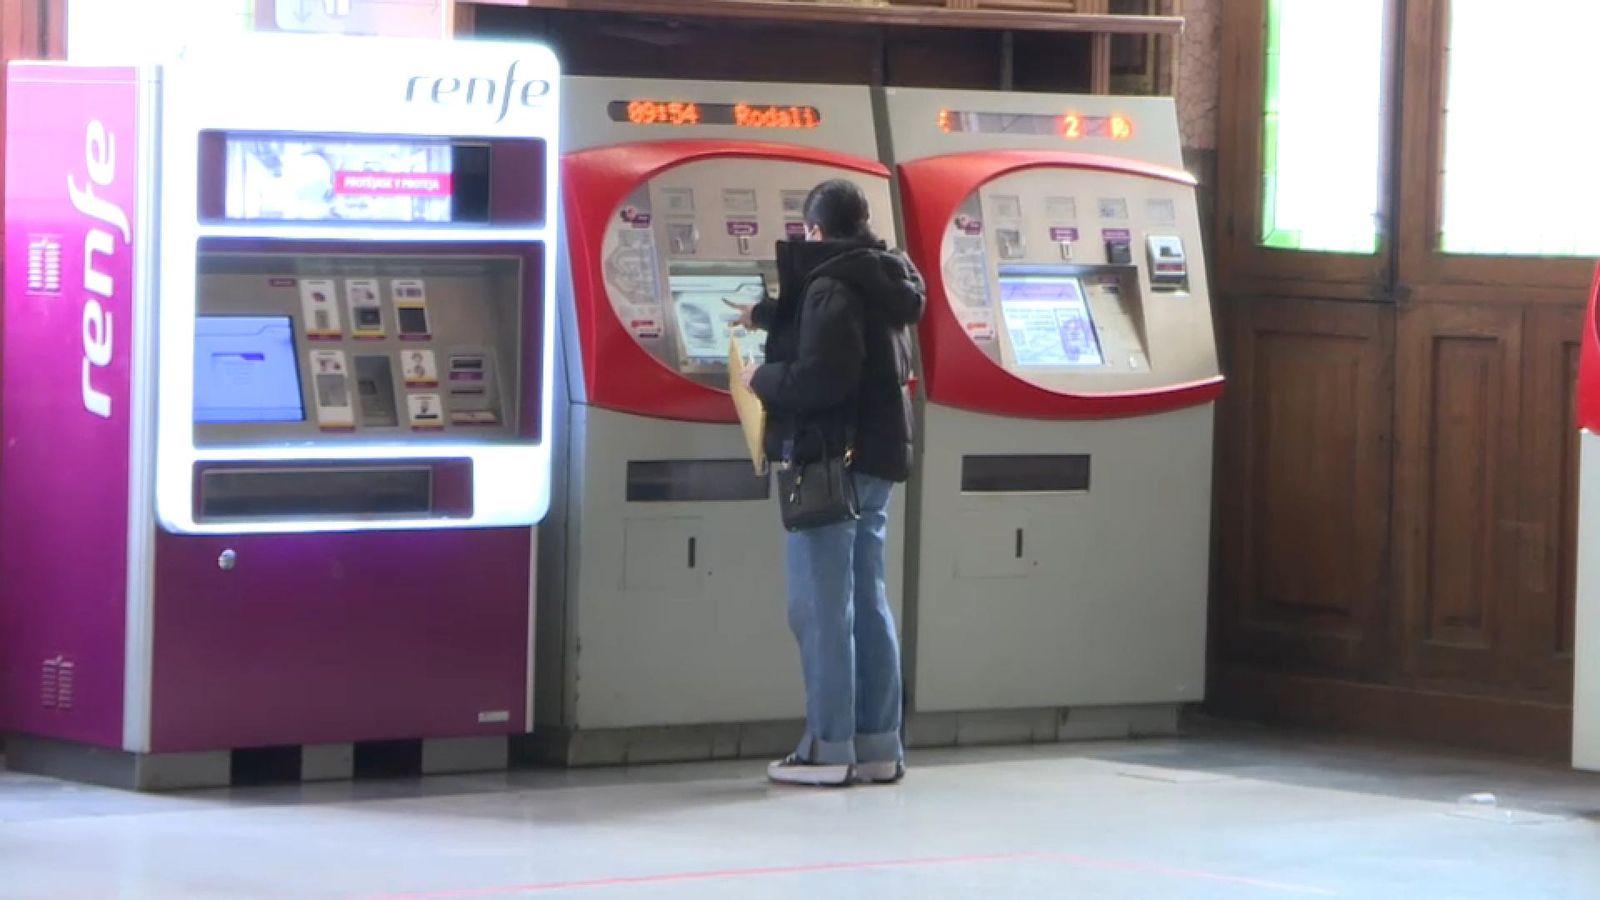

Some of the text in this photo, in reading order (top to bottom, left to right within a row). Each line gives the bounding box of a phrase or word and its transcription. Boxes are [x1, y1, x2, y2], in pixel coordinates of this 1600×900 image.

[405, 59, 550, 124] renfe
[628, 98, 700, 125] 09:54
[1064, 114, 1080, 138] 2
[66, 119, 131, 419] renfe
